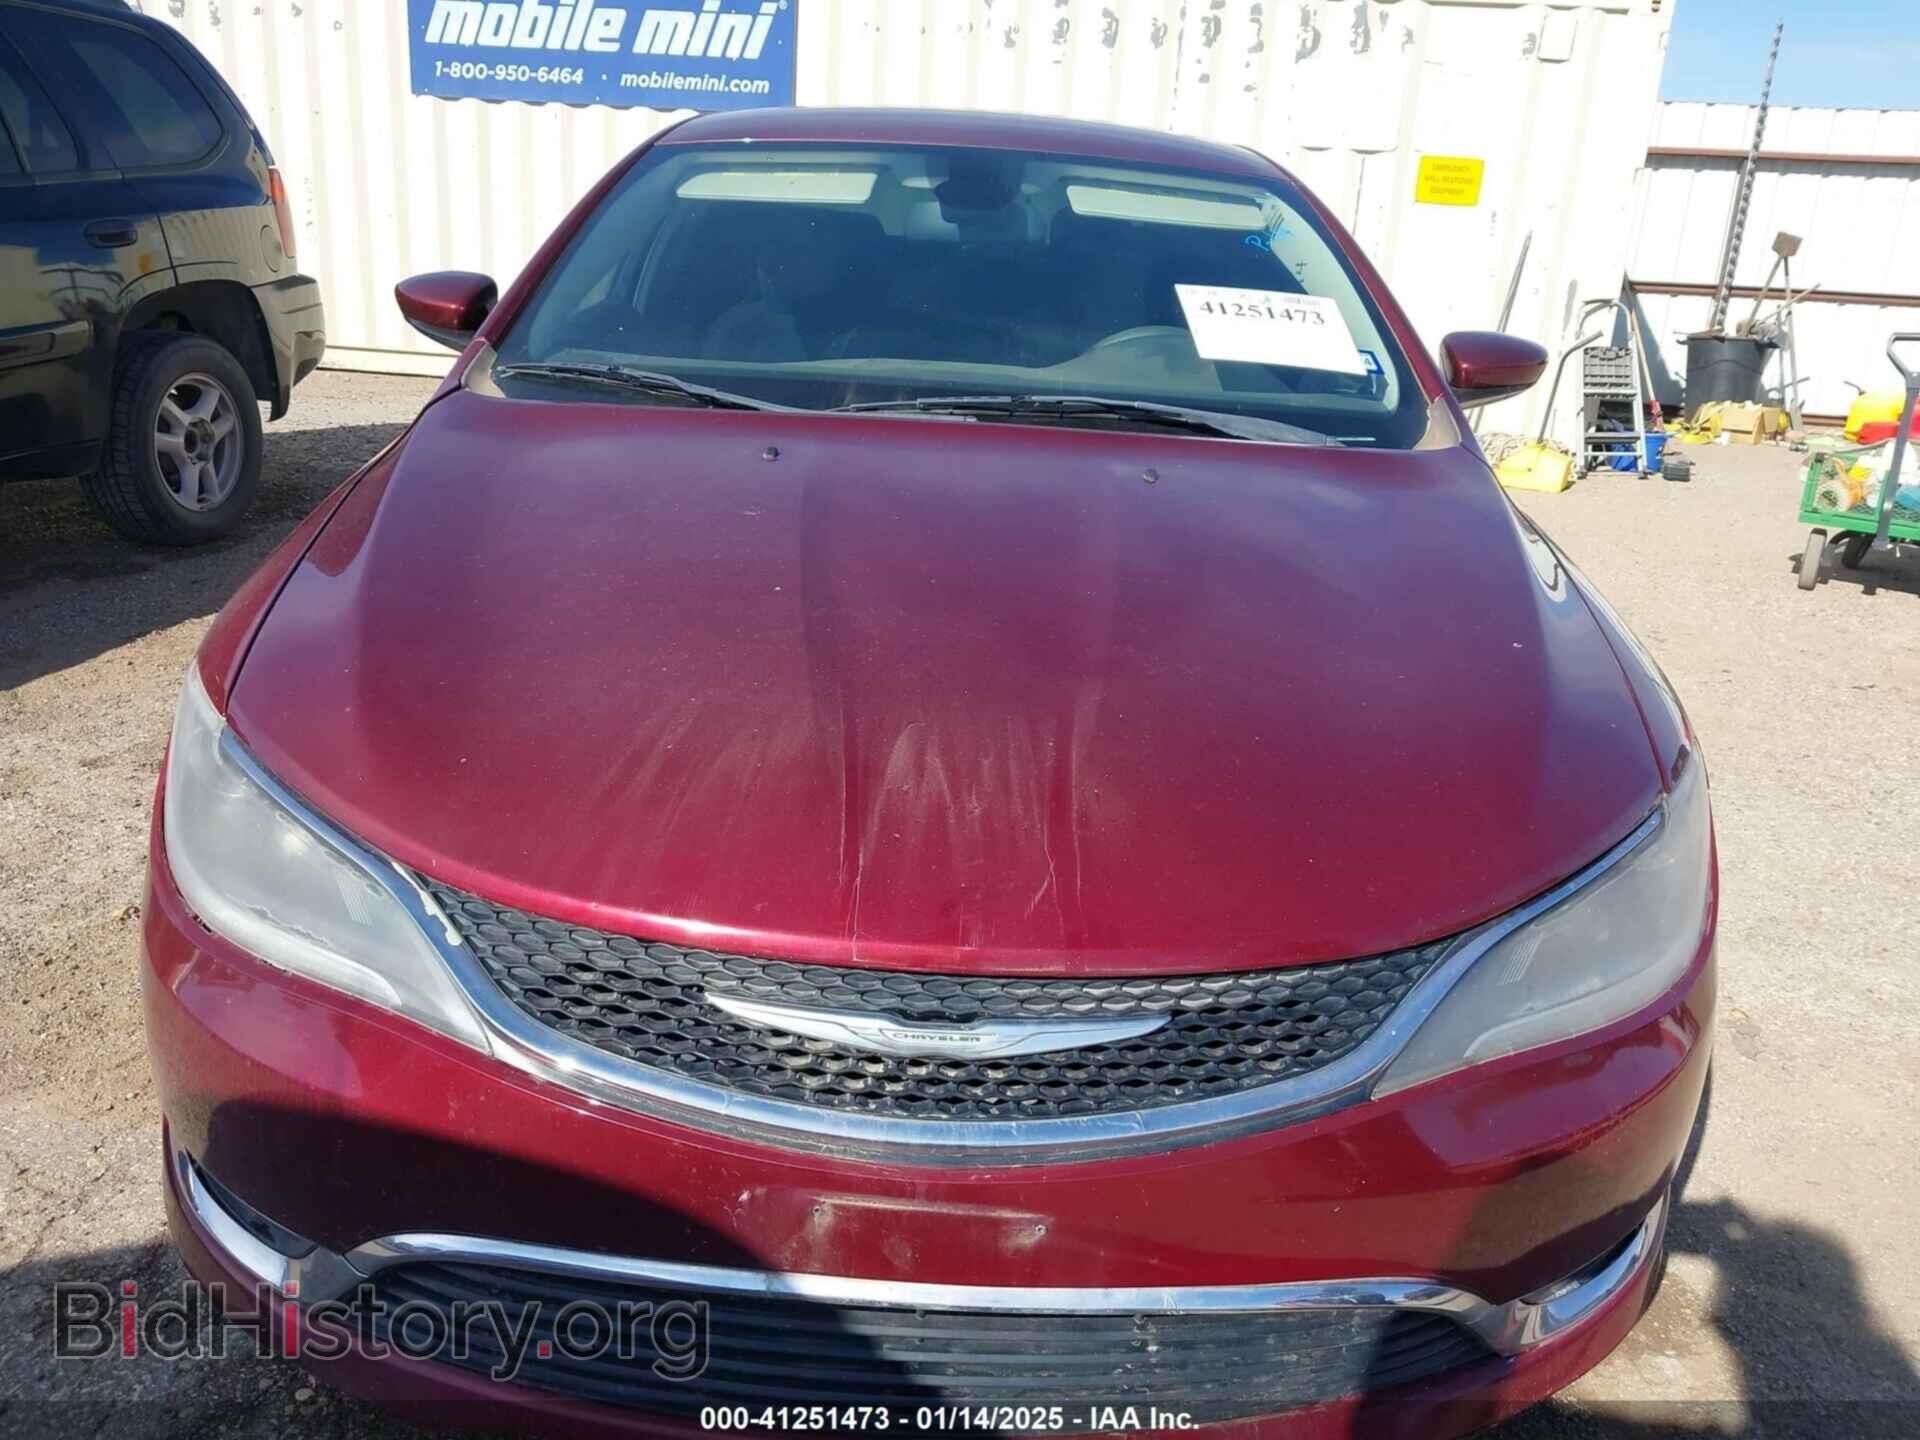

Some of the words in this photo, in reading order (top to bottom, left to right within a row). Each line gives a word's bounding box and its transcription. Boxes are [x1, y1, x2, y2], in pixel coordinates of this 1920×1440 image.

[425, 0, 627, 52] mobile
[434, 61, 584, 85] 1-800-950-6464
[620, 71, 770, 94] mobilemini.com
[1199, 301, 1326, 325] 41251473
[892, 1033, 981, 1042] CHRYSLER
